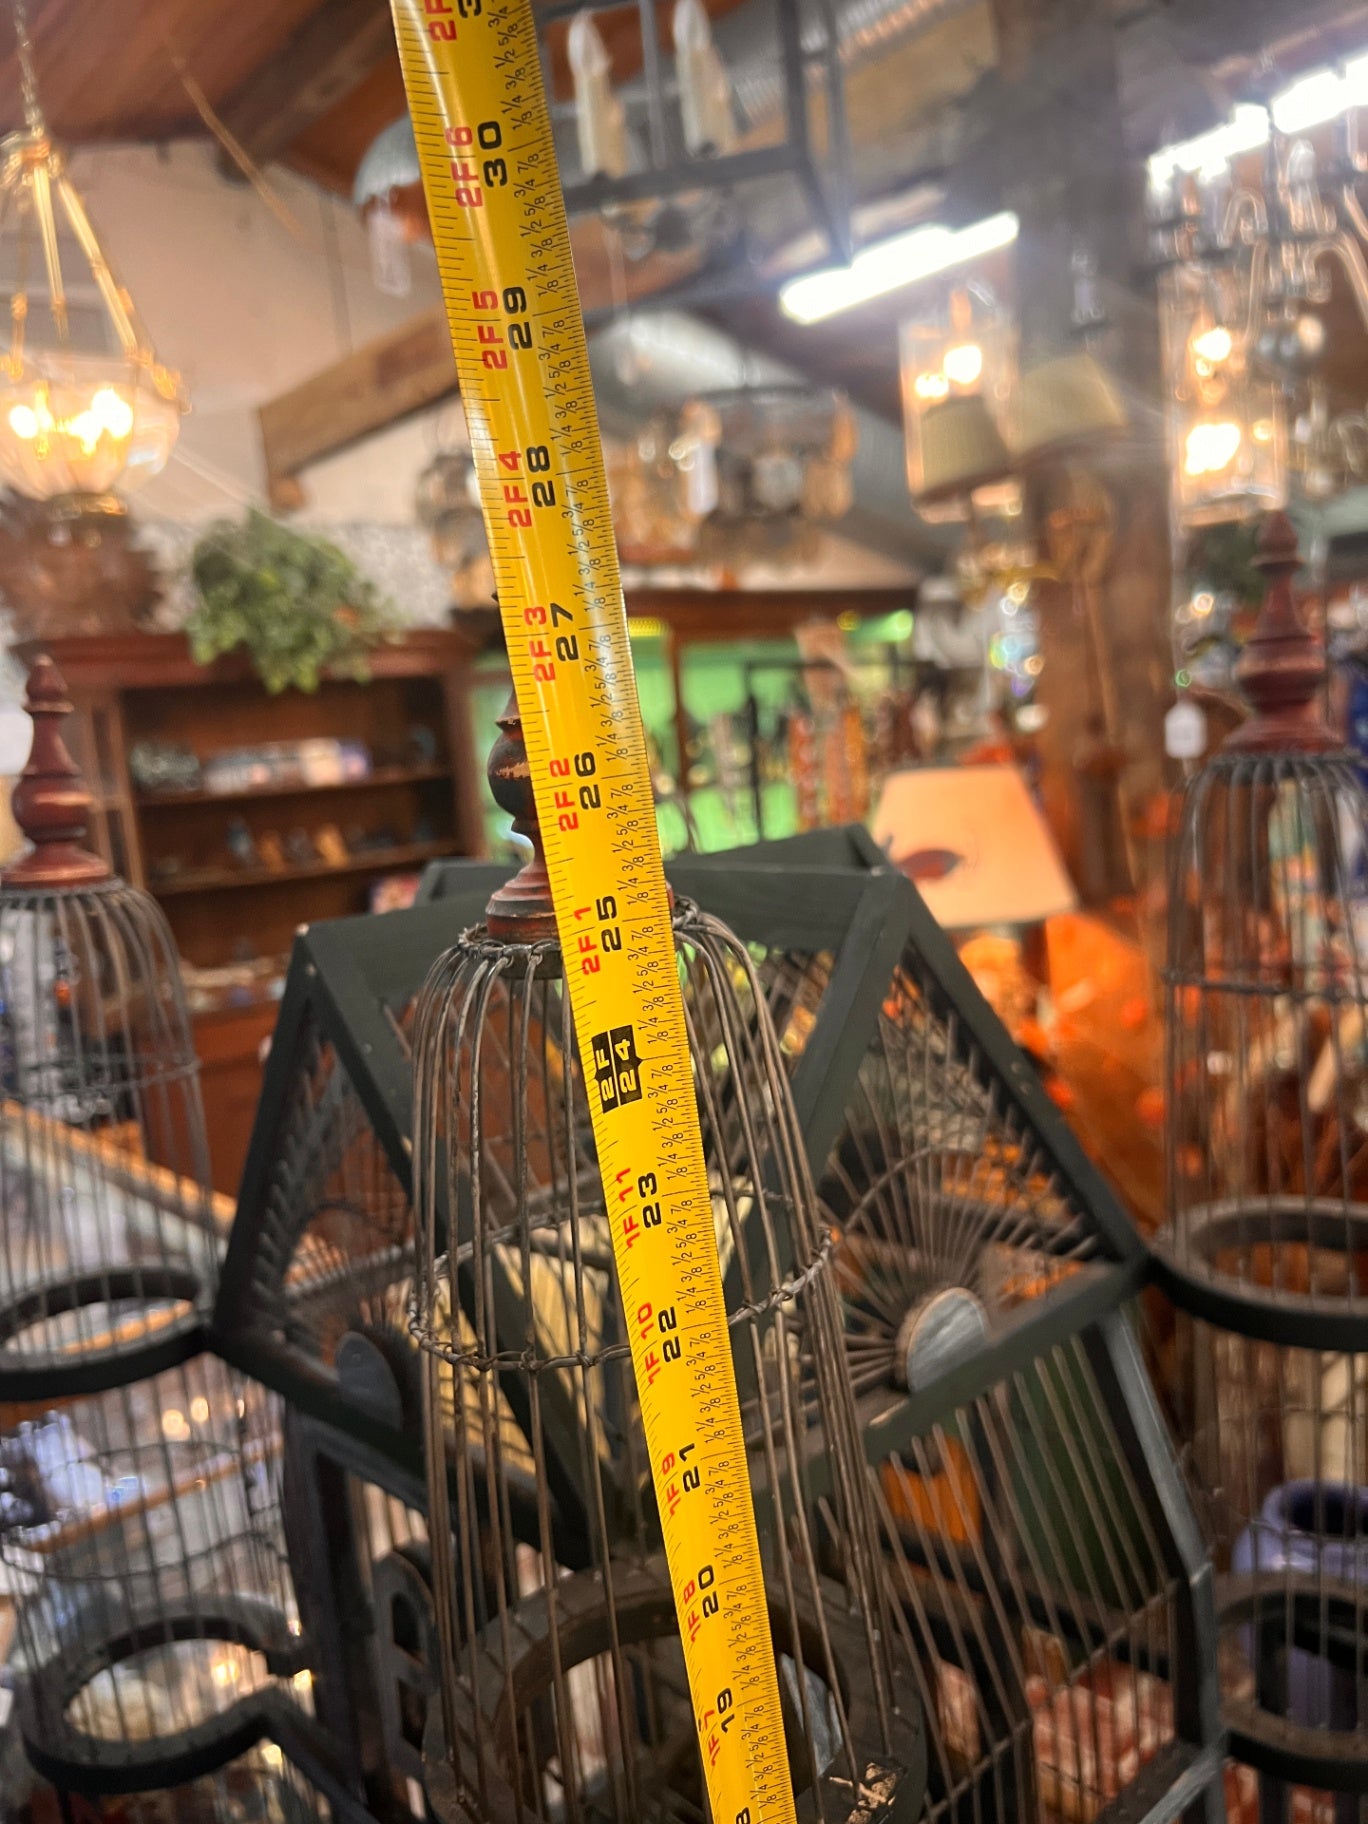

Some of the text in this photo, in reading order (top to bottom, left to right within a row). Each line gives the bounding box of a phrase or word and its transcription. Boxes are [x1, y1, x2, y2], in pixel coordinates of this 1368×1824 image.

[478, 121, 508, 187] 30
[503, 286, 533, 350] 29
[527, 445, 556, 507] 28
[550, 602, 579, 662] 27
[574, 752, 601, 810] 26
[596, 895, 622, 953] 25
[595, 1048, 614, 1101] 2F
[614, 1039, 636, 1093] 24
[637, 1172, 662, 1228] 23
[658, 1307, 681, 1363] 22
[679, 1442, 700, 1493] 21
[698, 1565, 719, 1618] 20
[717, 1687, 735, 1733] 19
